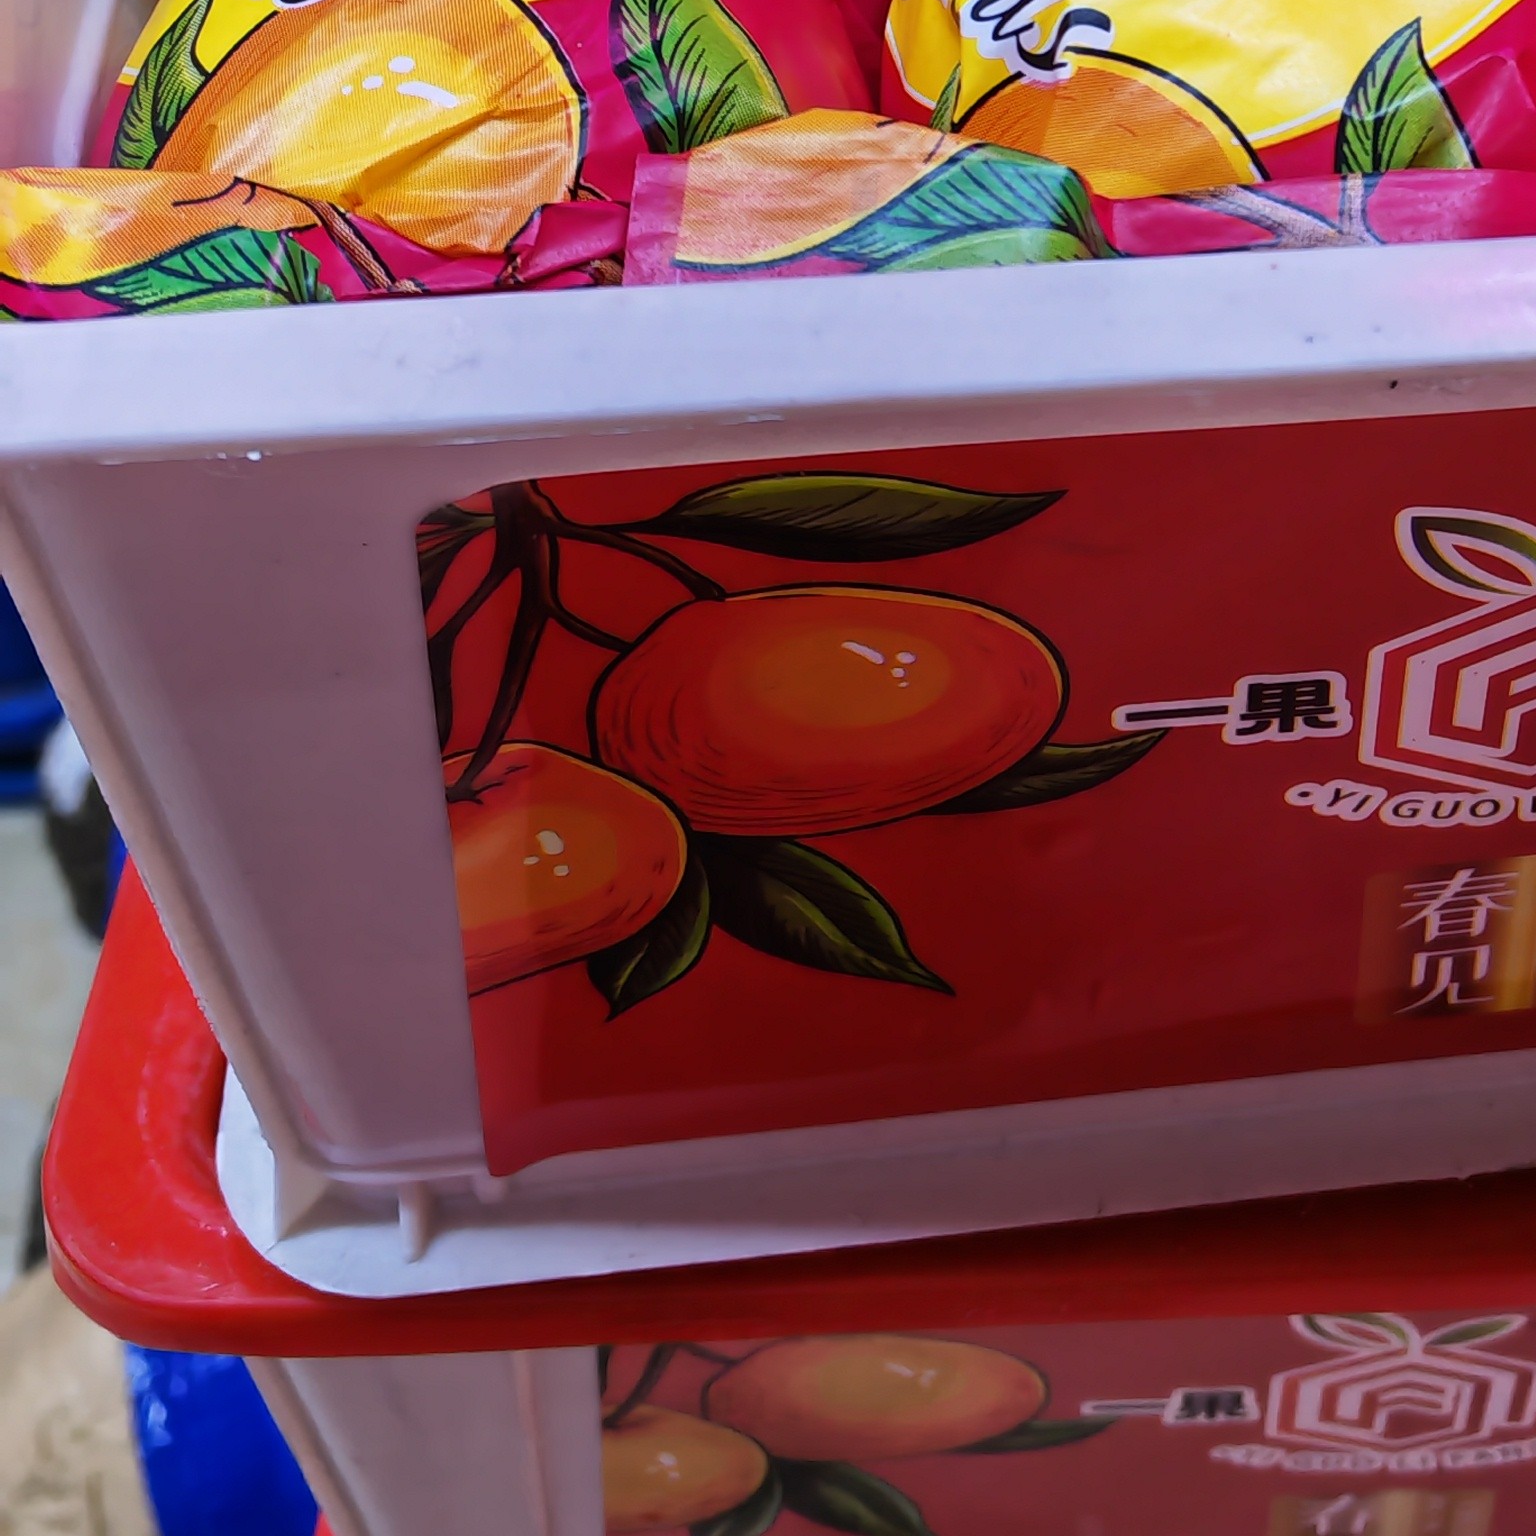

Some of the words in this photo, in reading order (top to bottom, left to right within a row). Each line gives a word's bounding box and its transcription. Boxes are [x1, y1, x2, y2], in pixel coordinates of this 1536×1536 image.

[1125, 678, 1338, 736] 一果
[1325, 786, 1374, 814] YI
[1392, 797, 1501, 820] GUO
[1394, 867, 1519, 1014] 春见
[1091, 1390, 1248, 1420] 一果
